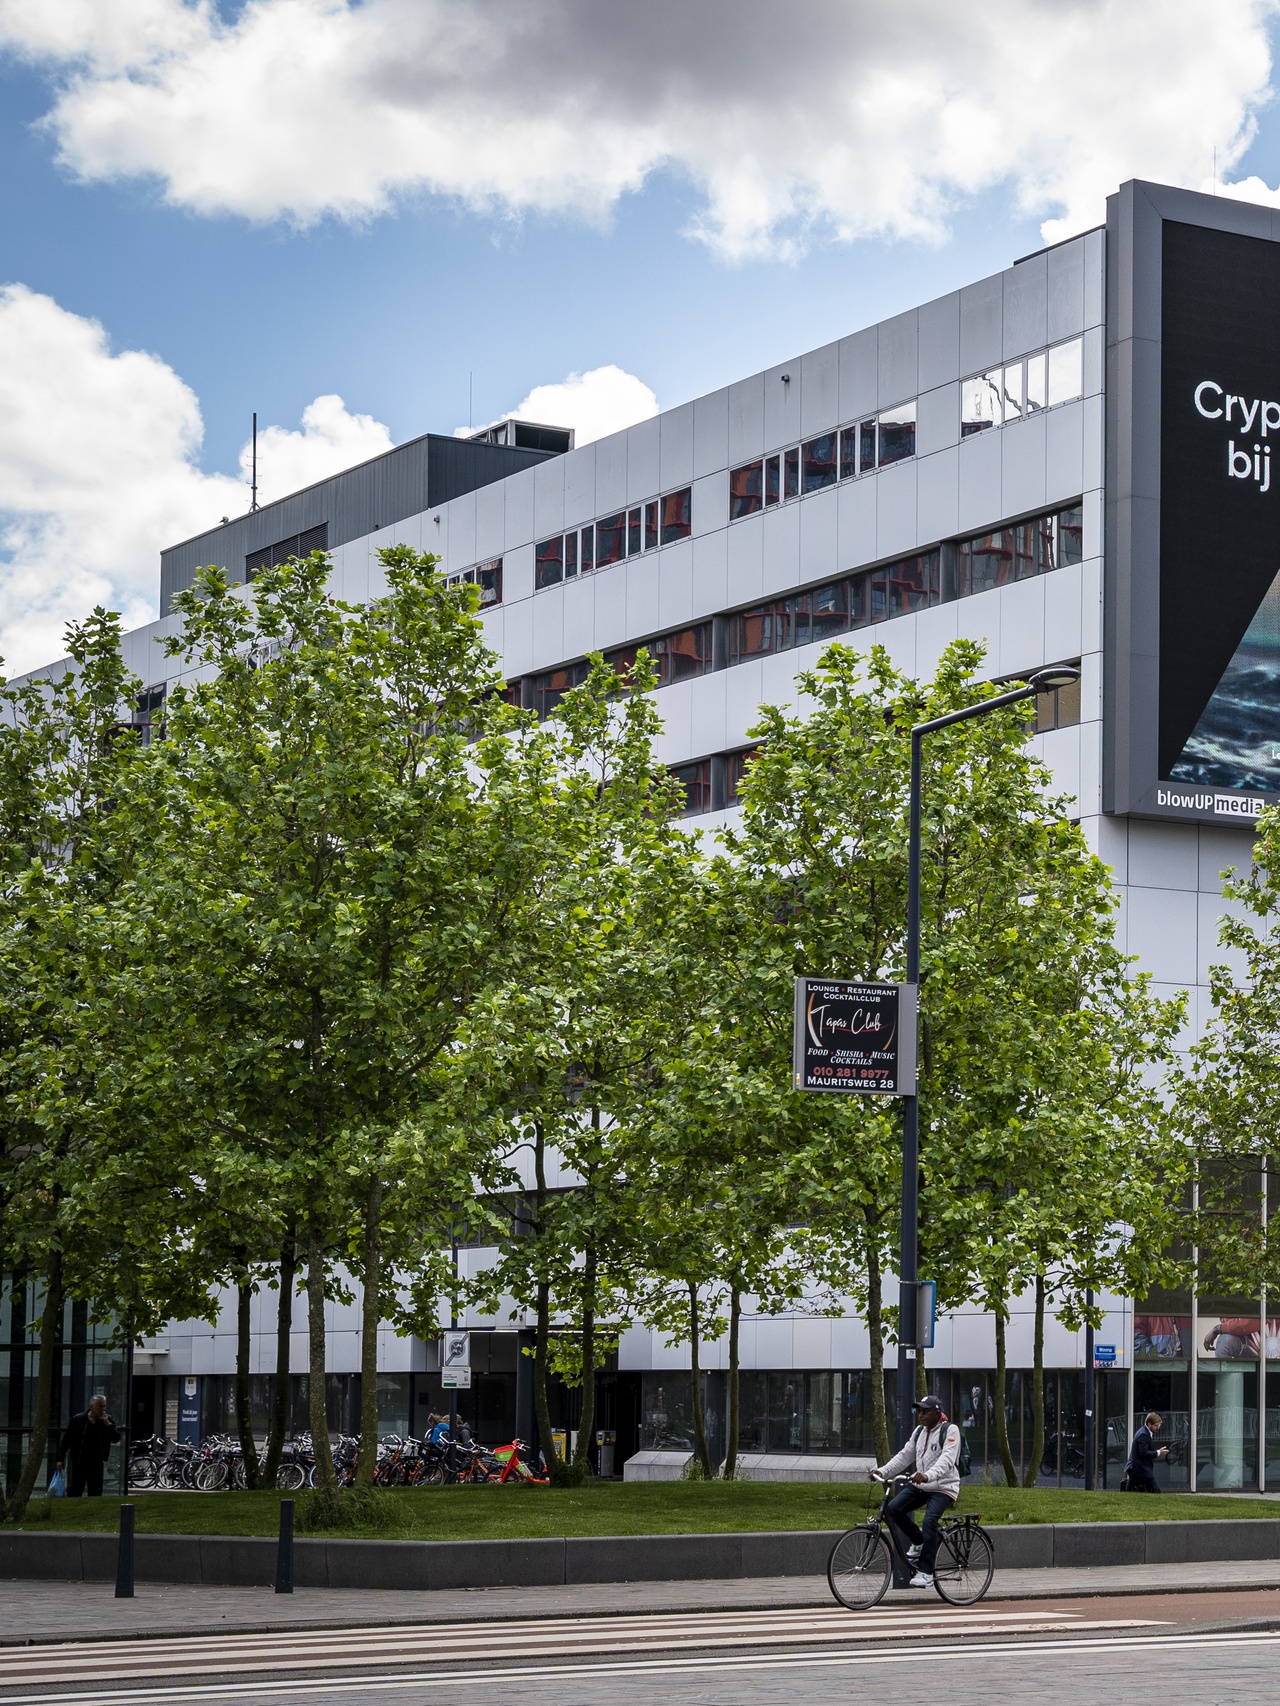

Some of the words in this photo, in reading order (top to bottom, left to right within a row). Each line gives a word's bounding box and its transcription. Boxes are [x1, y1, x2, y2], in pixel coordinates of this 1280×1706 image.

[1228, 441, 1272, 493] bij
[807, 984, 840, 993] LOUNGE
[847, 986, 897, 997] RESTAURANT
[823, 993, 881, 1003] COCKTAILCLUB
[810, 1004, 848, 1038] Tapas
[851, 1008, 882, 1035] Club
[807, 1047, 829, 1056] FOOD
[835, 1049, 864, 1058] SHISHA
[870, 1051, 895, 1060] MUSIC
[830, 1056, 873, 1065] COCKTAILS
[813, 1066, 833, 1076] 010
[836, 1068, 857, 1078] 281
[860, 1069, 889, 1079] 9977
[807, 1075, 876, 1088] MAURITSWEG
[880, 1079, 894, 1089] 28
